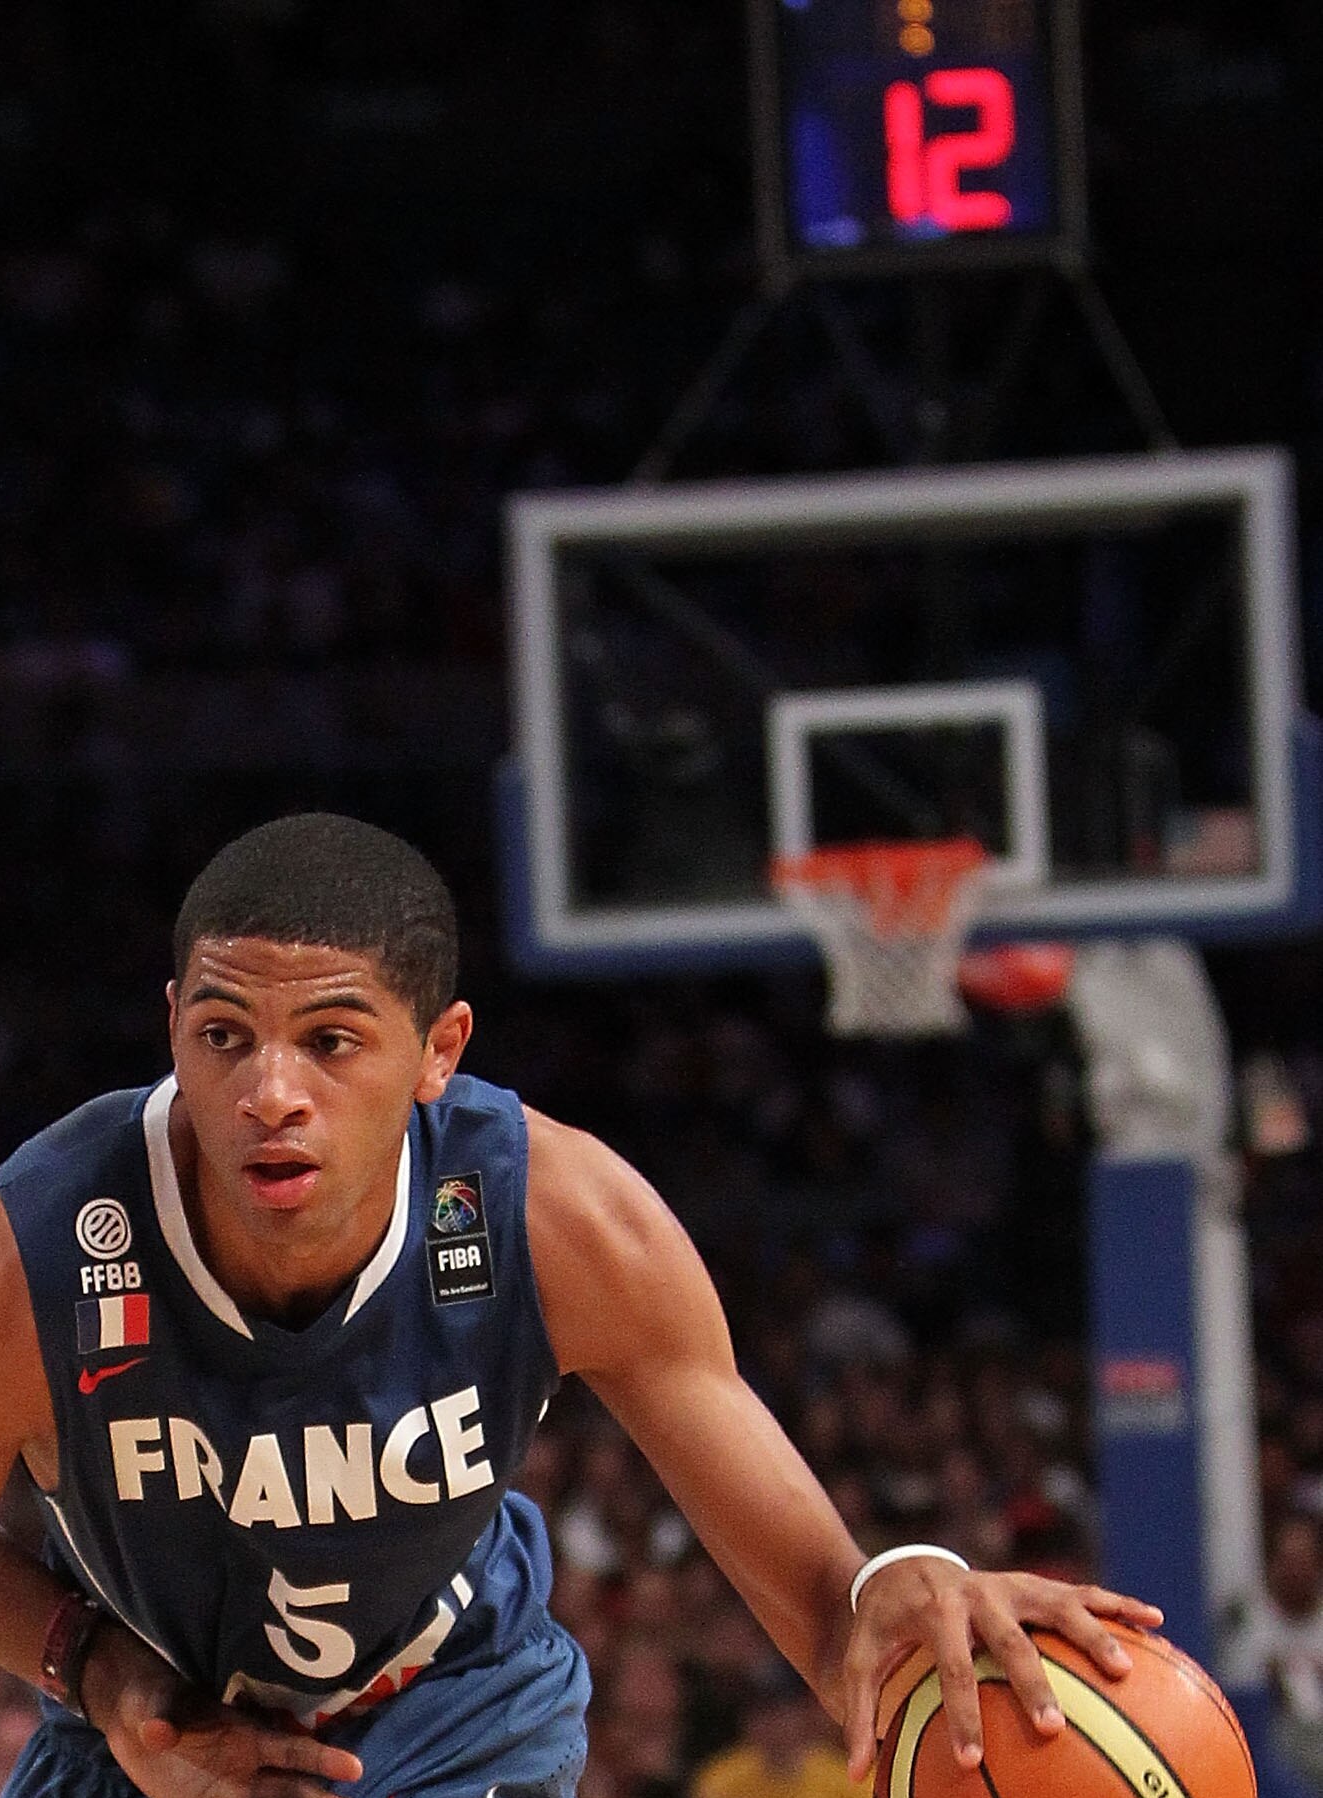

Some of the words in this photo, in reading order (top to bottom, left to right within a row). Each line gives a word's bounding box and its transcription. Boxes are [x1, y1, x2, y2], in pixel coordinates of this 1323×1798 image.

[884, 67, 1015, 231] 12
[80, 1261, 142, 1294] FFBB
[438, 1245, 482, 1272] FIBA
[109, 1386, 494, 1529] FRANCE
[264, 1568, 356, 1679] 5
